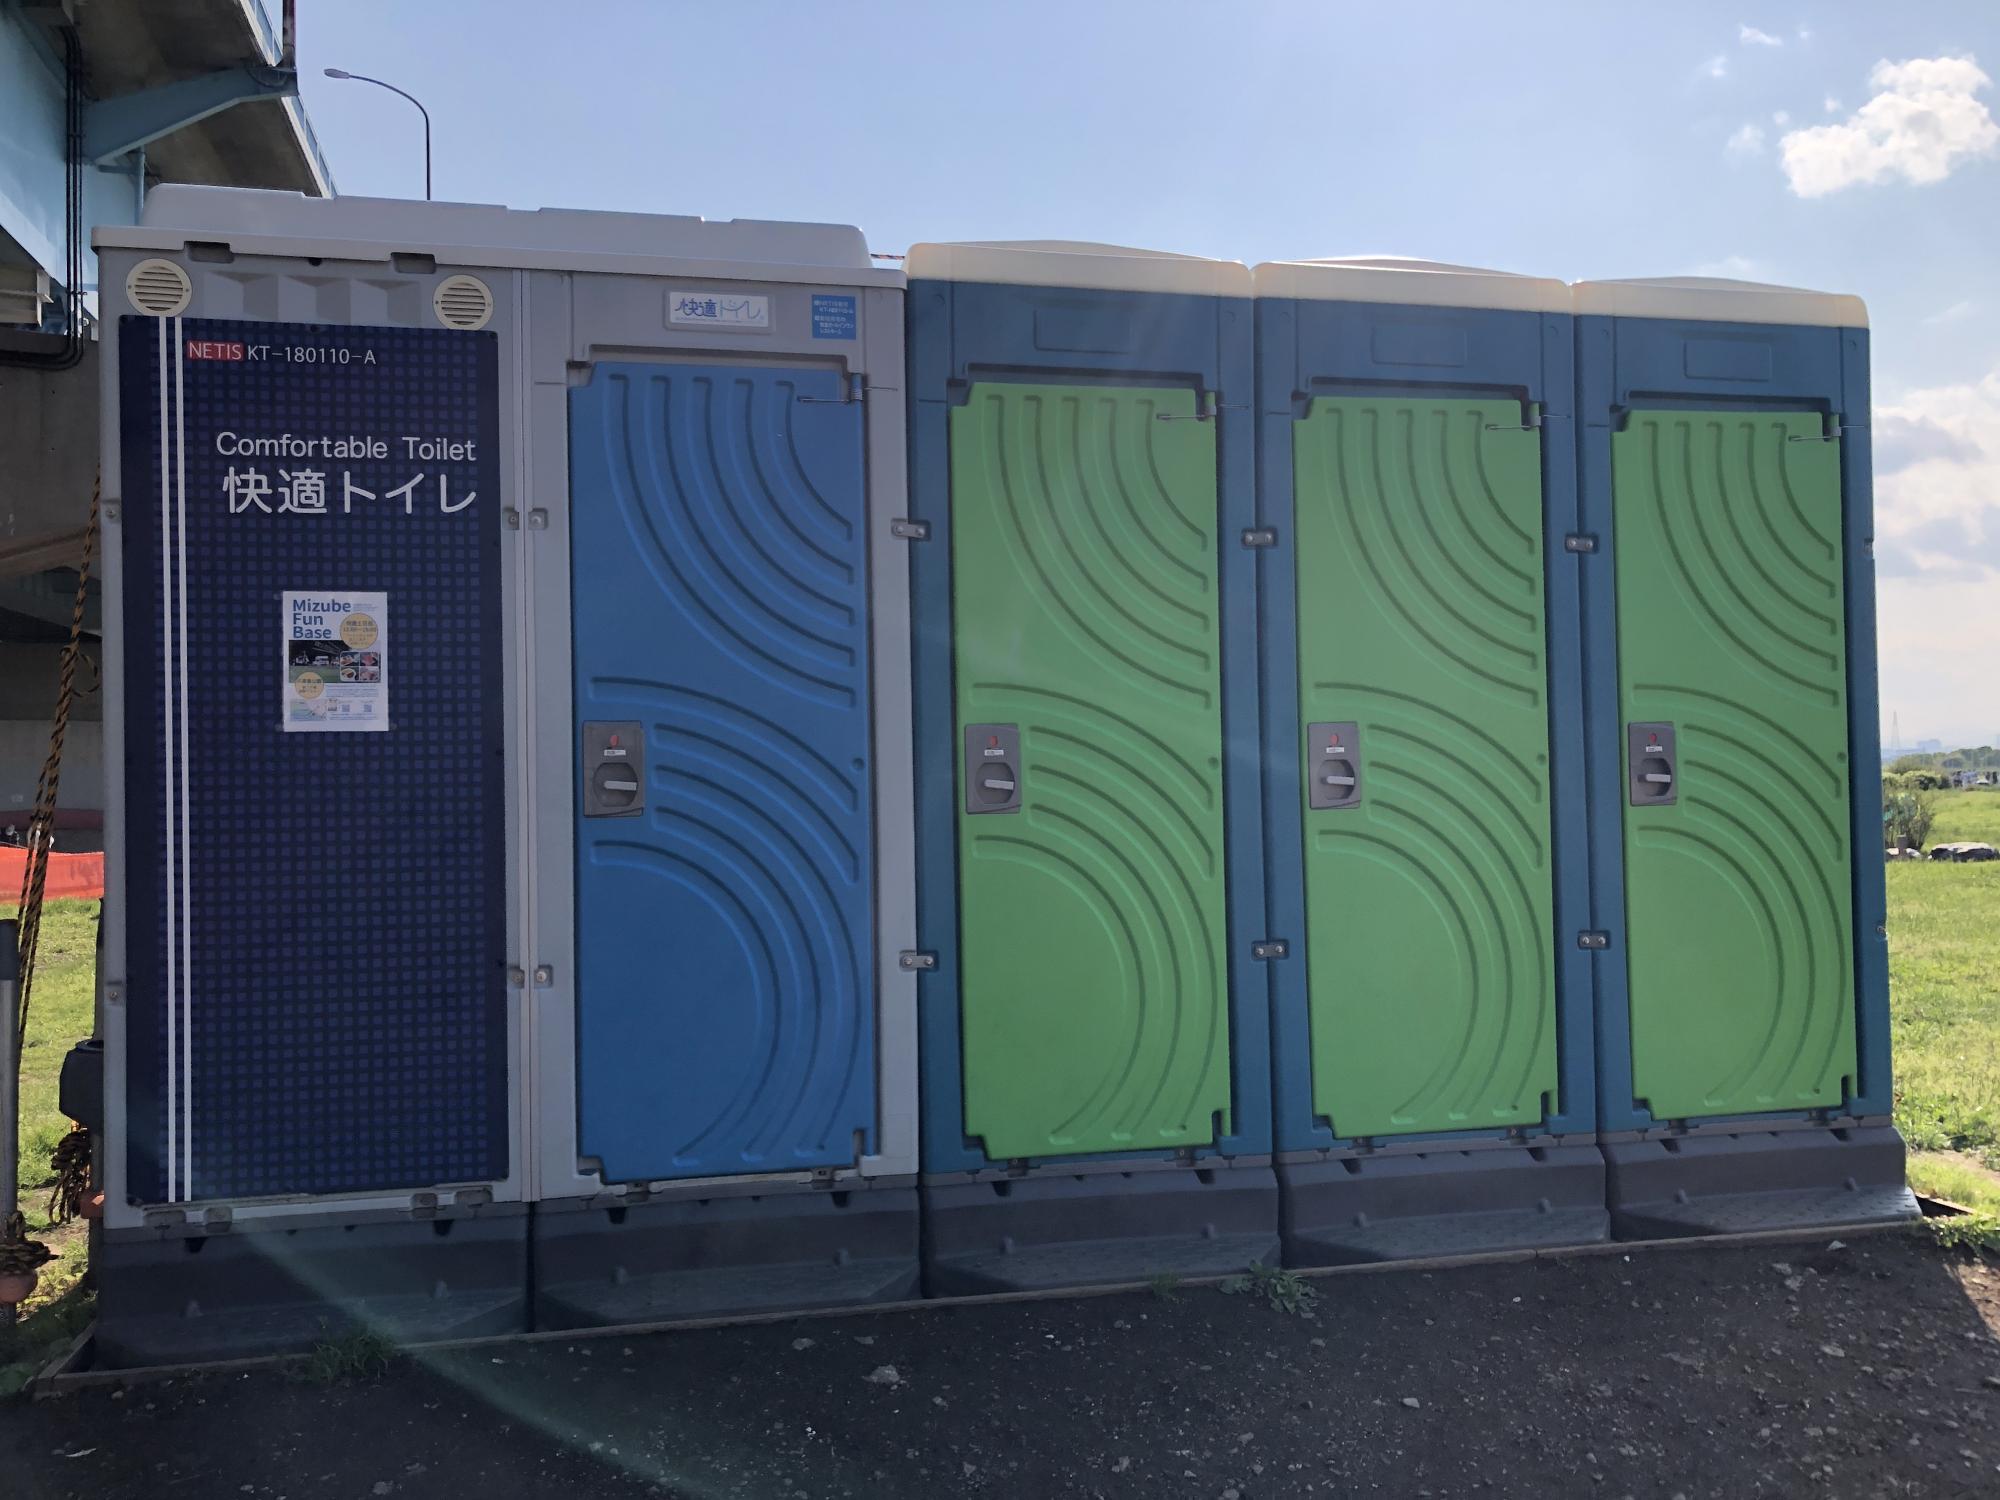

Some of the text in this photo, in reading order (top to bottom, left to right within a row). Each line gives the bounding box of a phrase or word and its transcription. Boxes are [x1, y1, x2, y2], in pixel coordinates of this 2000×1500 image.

[675, 297, 761, 319] 快適トイレ
[188, 341, 376, 365] NETIS KT-180110-A
[216, 431, 477, 462] Comfortable Toilet
[222, 466, 477, 514] 快適トイレ
[293, 599, 351, 612] Mizube
[293, 613, 323, 626] Fun
[293, 626, 332, 638] Base
